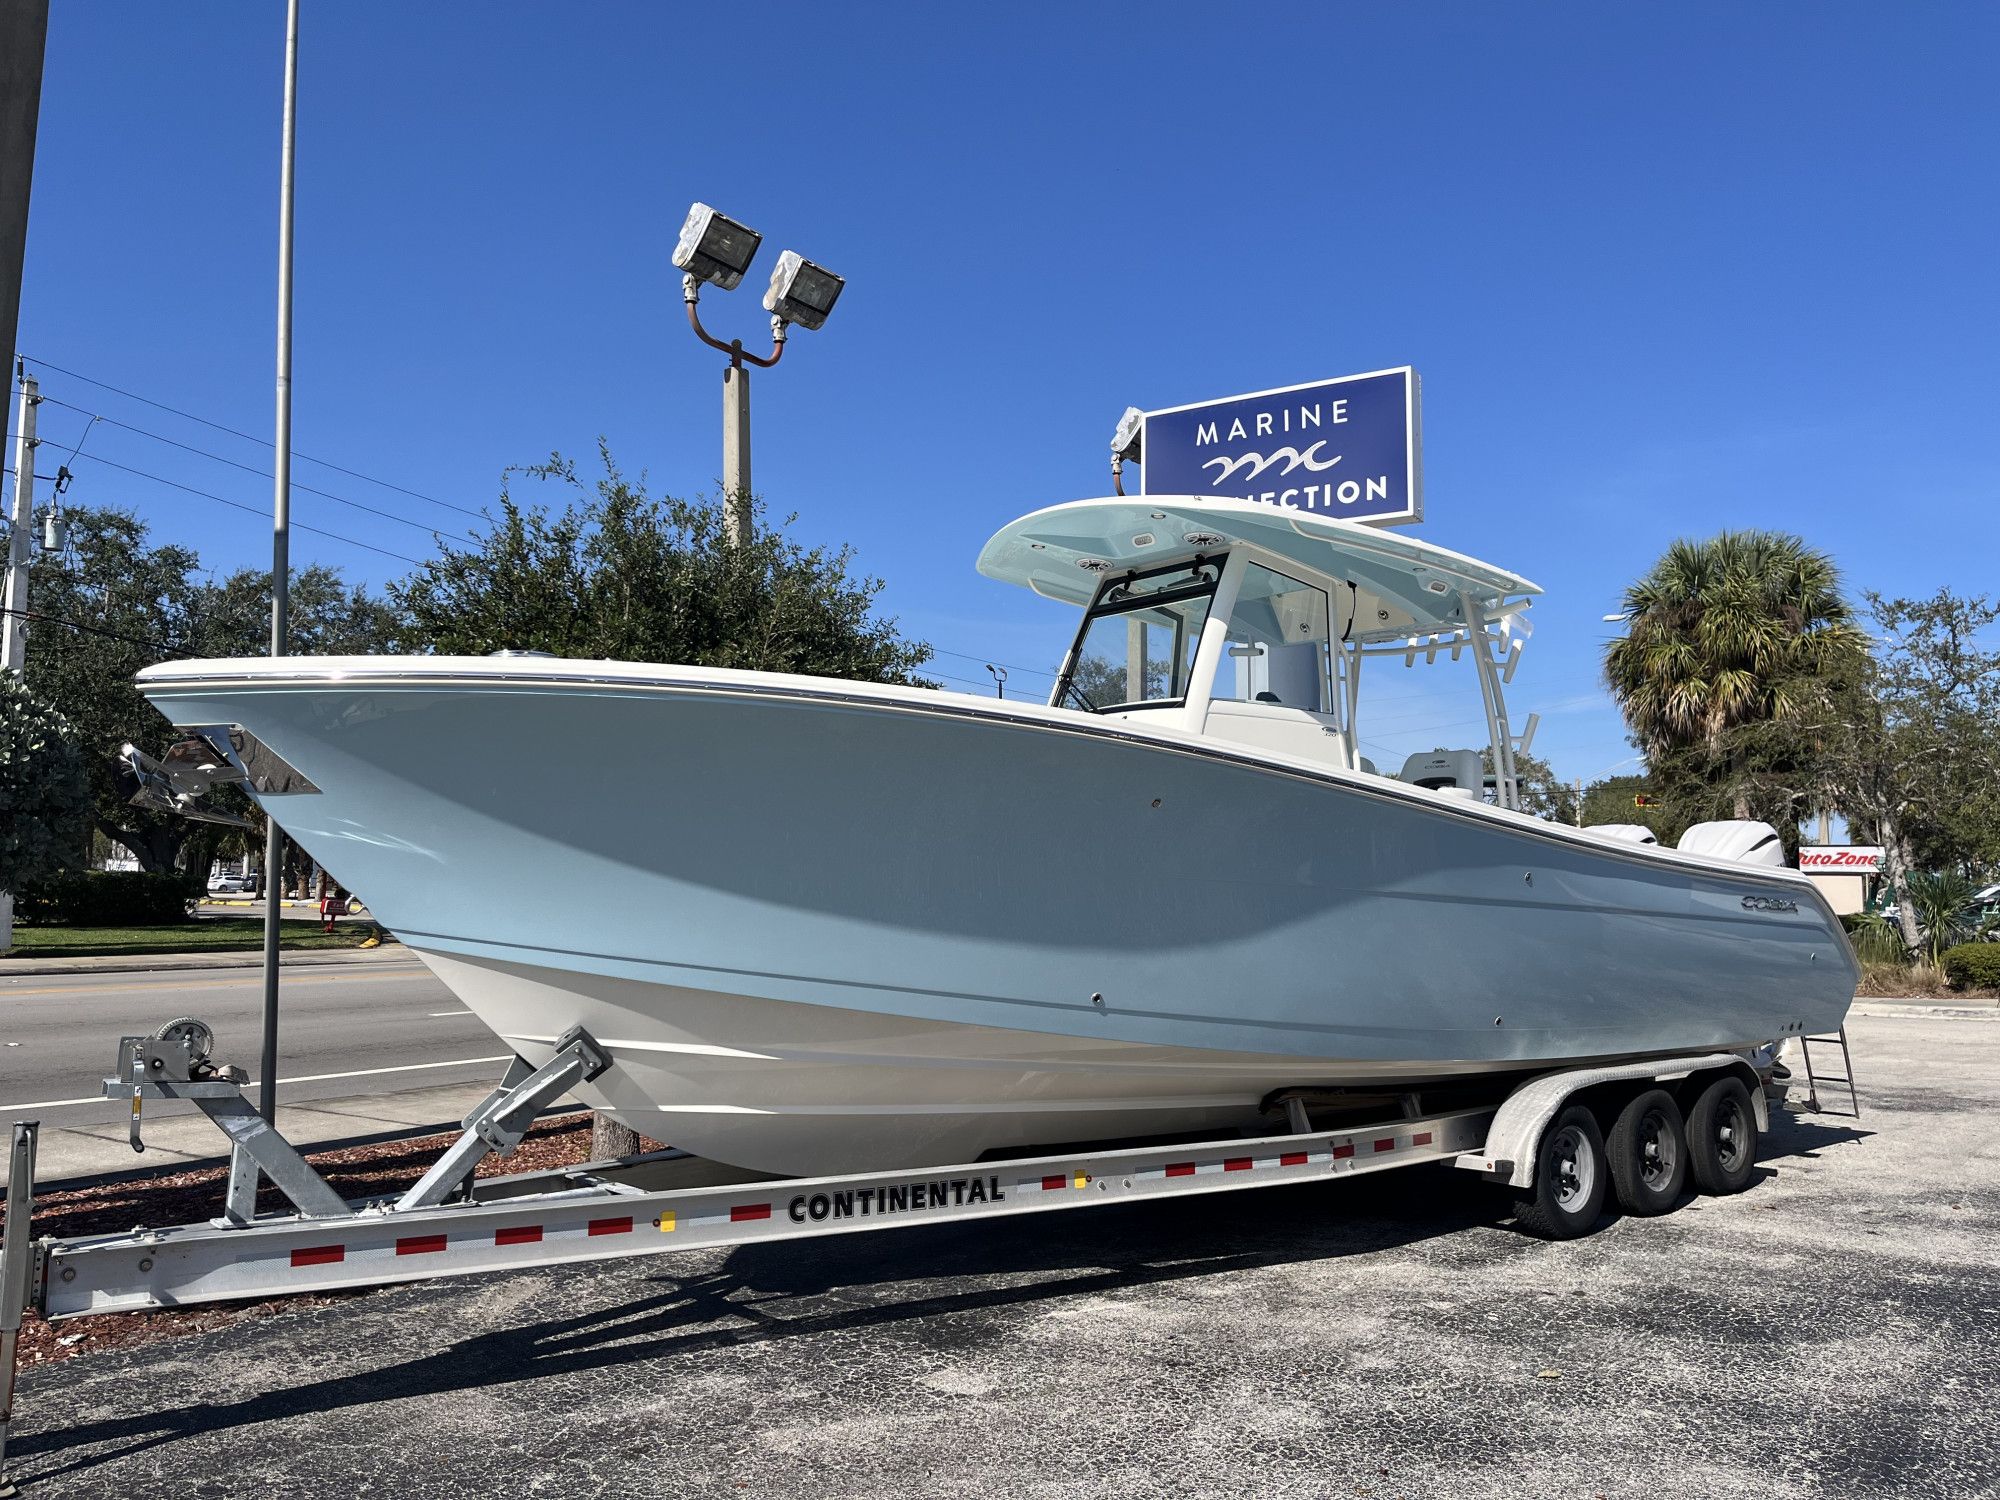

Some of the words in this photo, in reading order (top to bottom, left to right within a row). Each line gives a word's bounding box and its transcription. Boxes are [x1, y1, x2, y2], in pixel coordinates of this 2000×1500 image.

[1196, 399, 1348, 446] MARINE
[1235, 476, 1387, 512] ECTION
[789, 1176, 1006, 1225] CONTINENTAL
